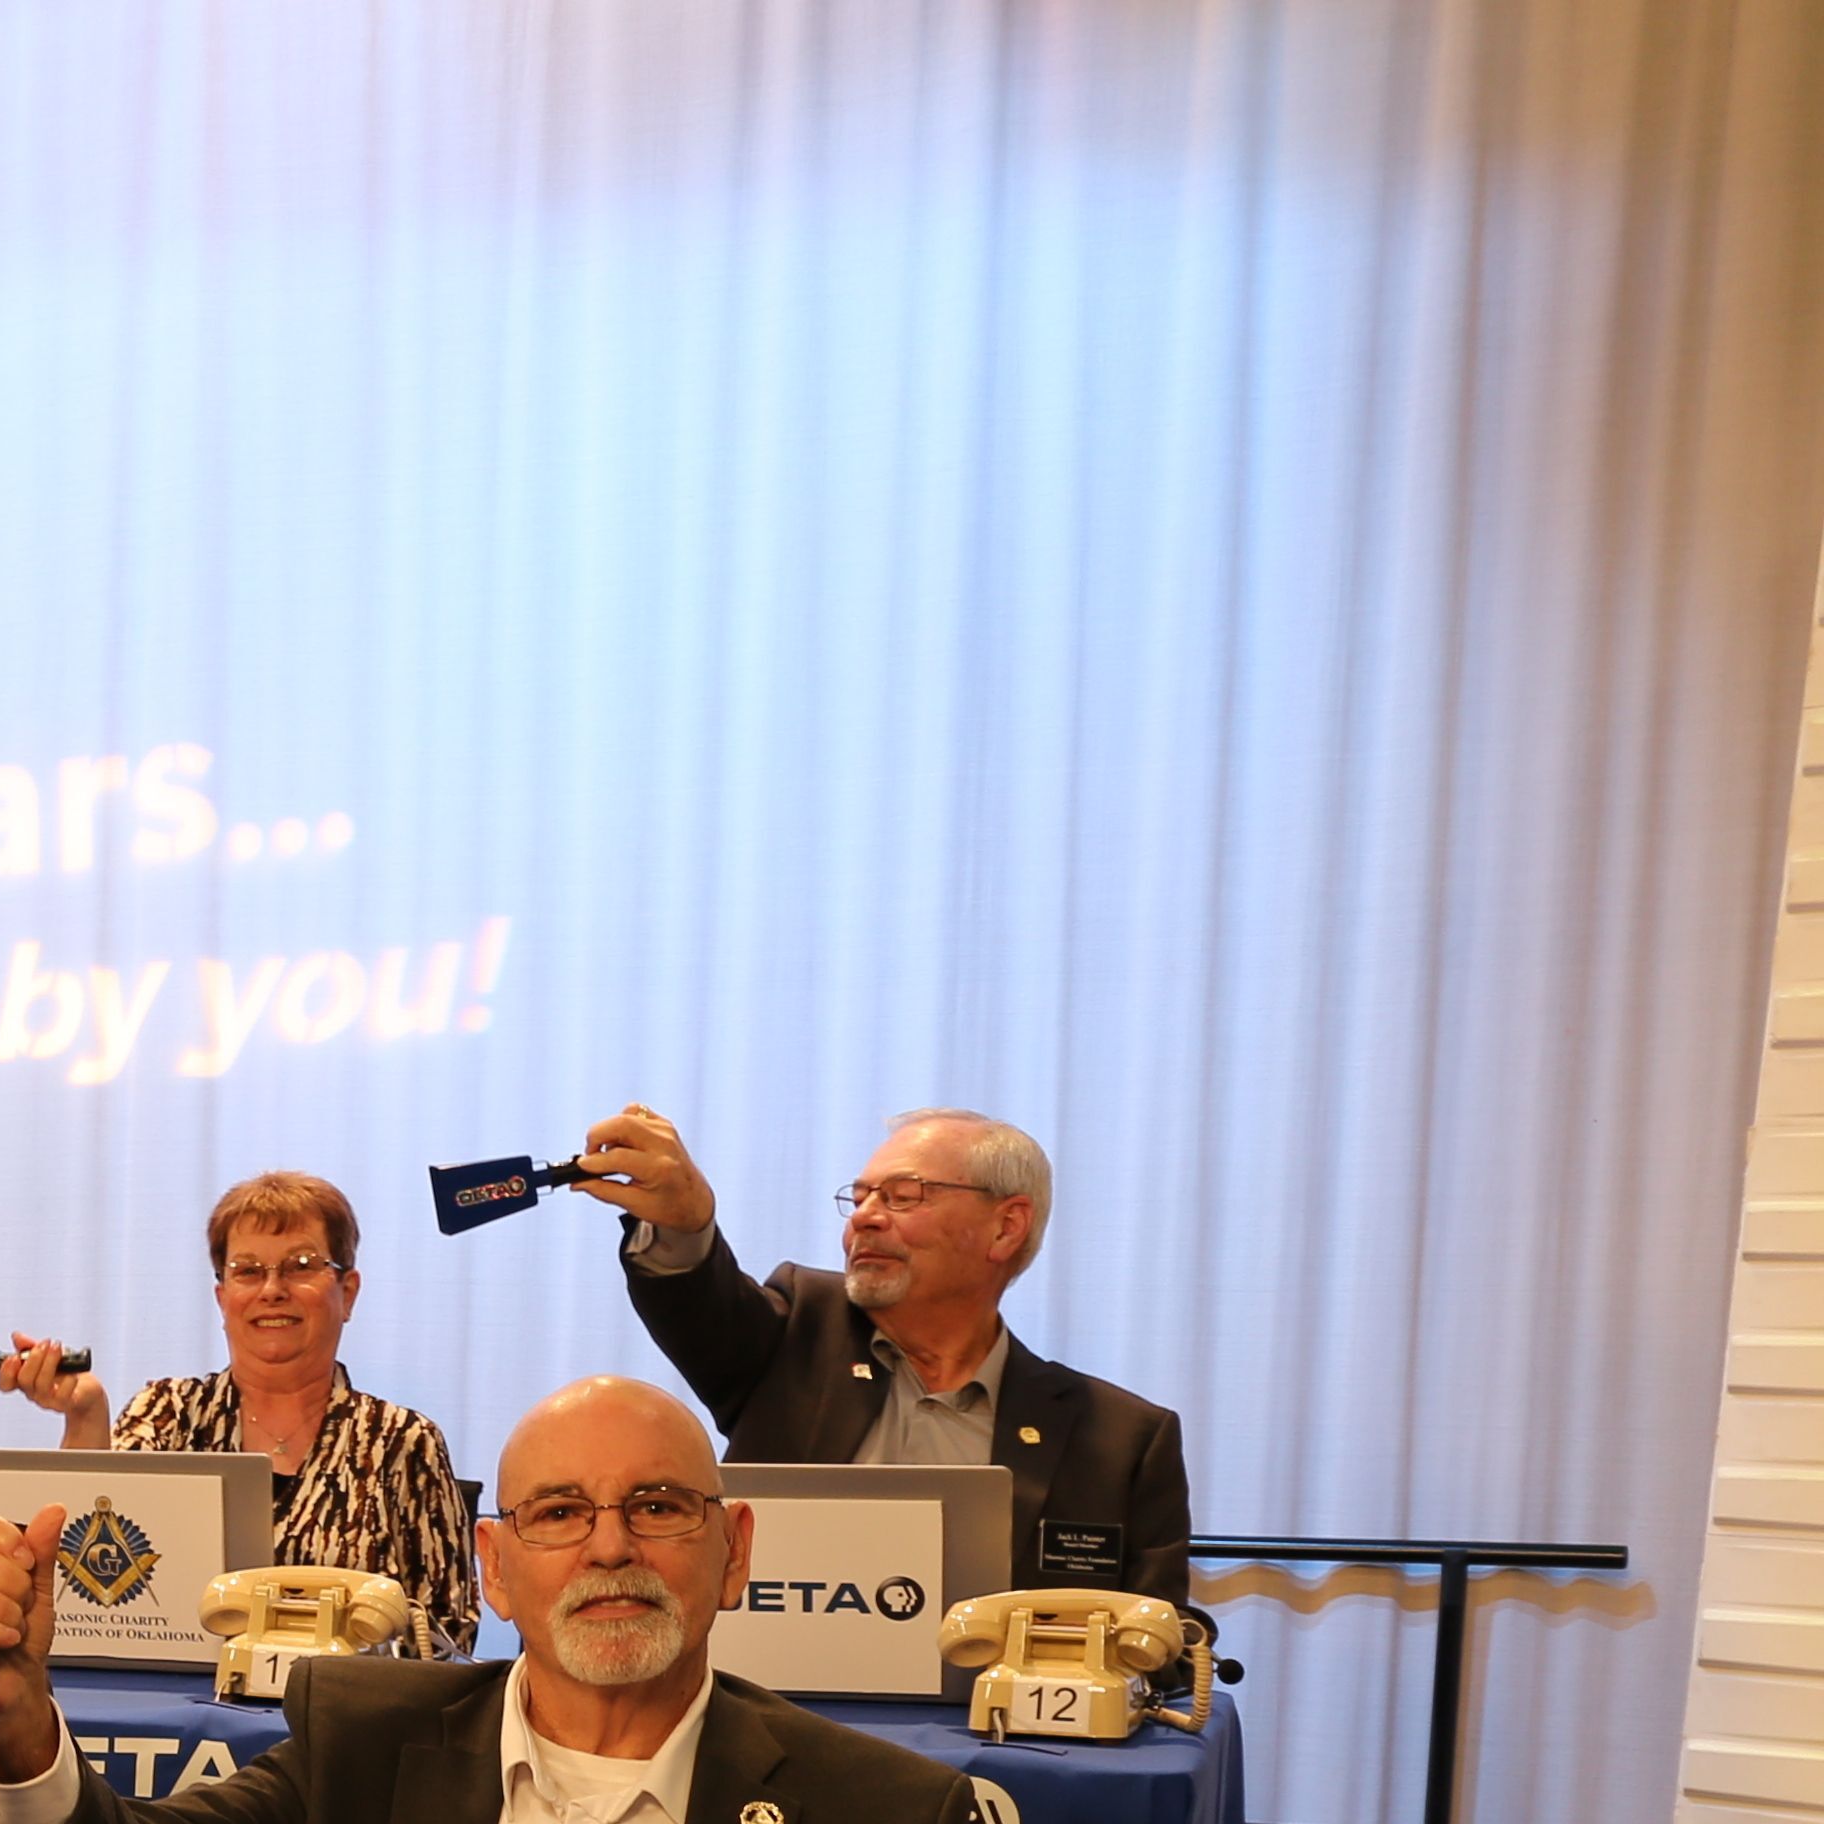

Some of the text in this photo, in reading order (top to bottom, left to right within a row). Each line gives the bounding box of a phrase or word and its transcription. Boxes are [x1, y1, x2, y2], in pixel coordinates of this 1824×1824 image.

[177, 916, 514, 1079] you!
[718, 1581, 872, 1615] ETA
[54, 1626, 103, 1639] DATION
[126, 1629, 205, 1643] OKLAHOMA
[110, 1613, 169, 1627] CHARITY
[1028, 1686, 1078, 1722] 12
